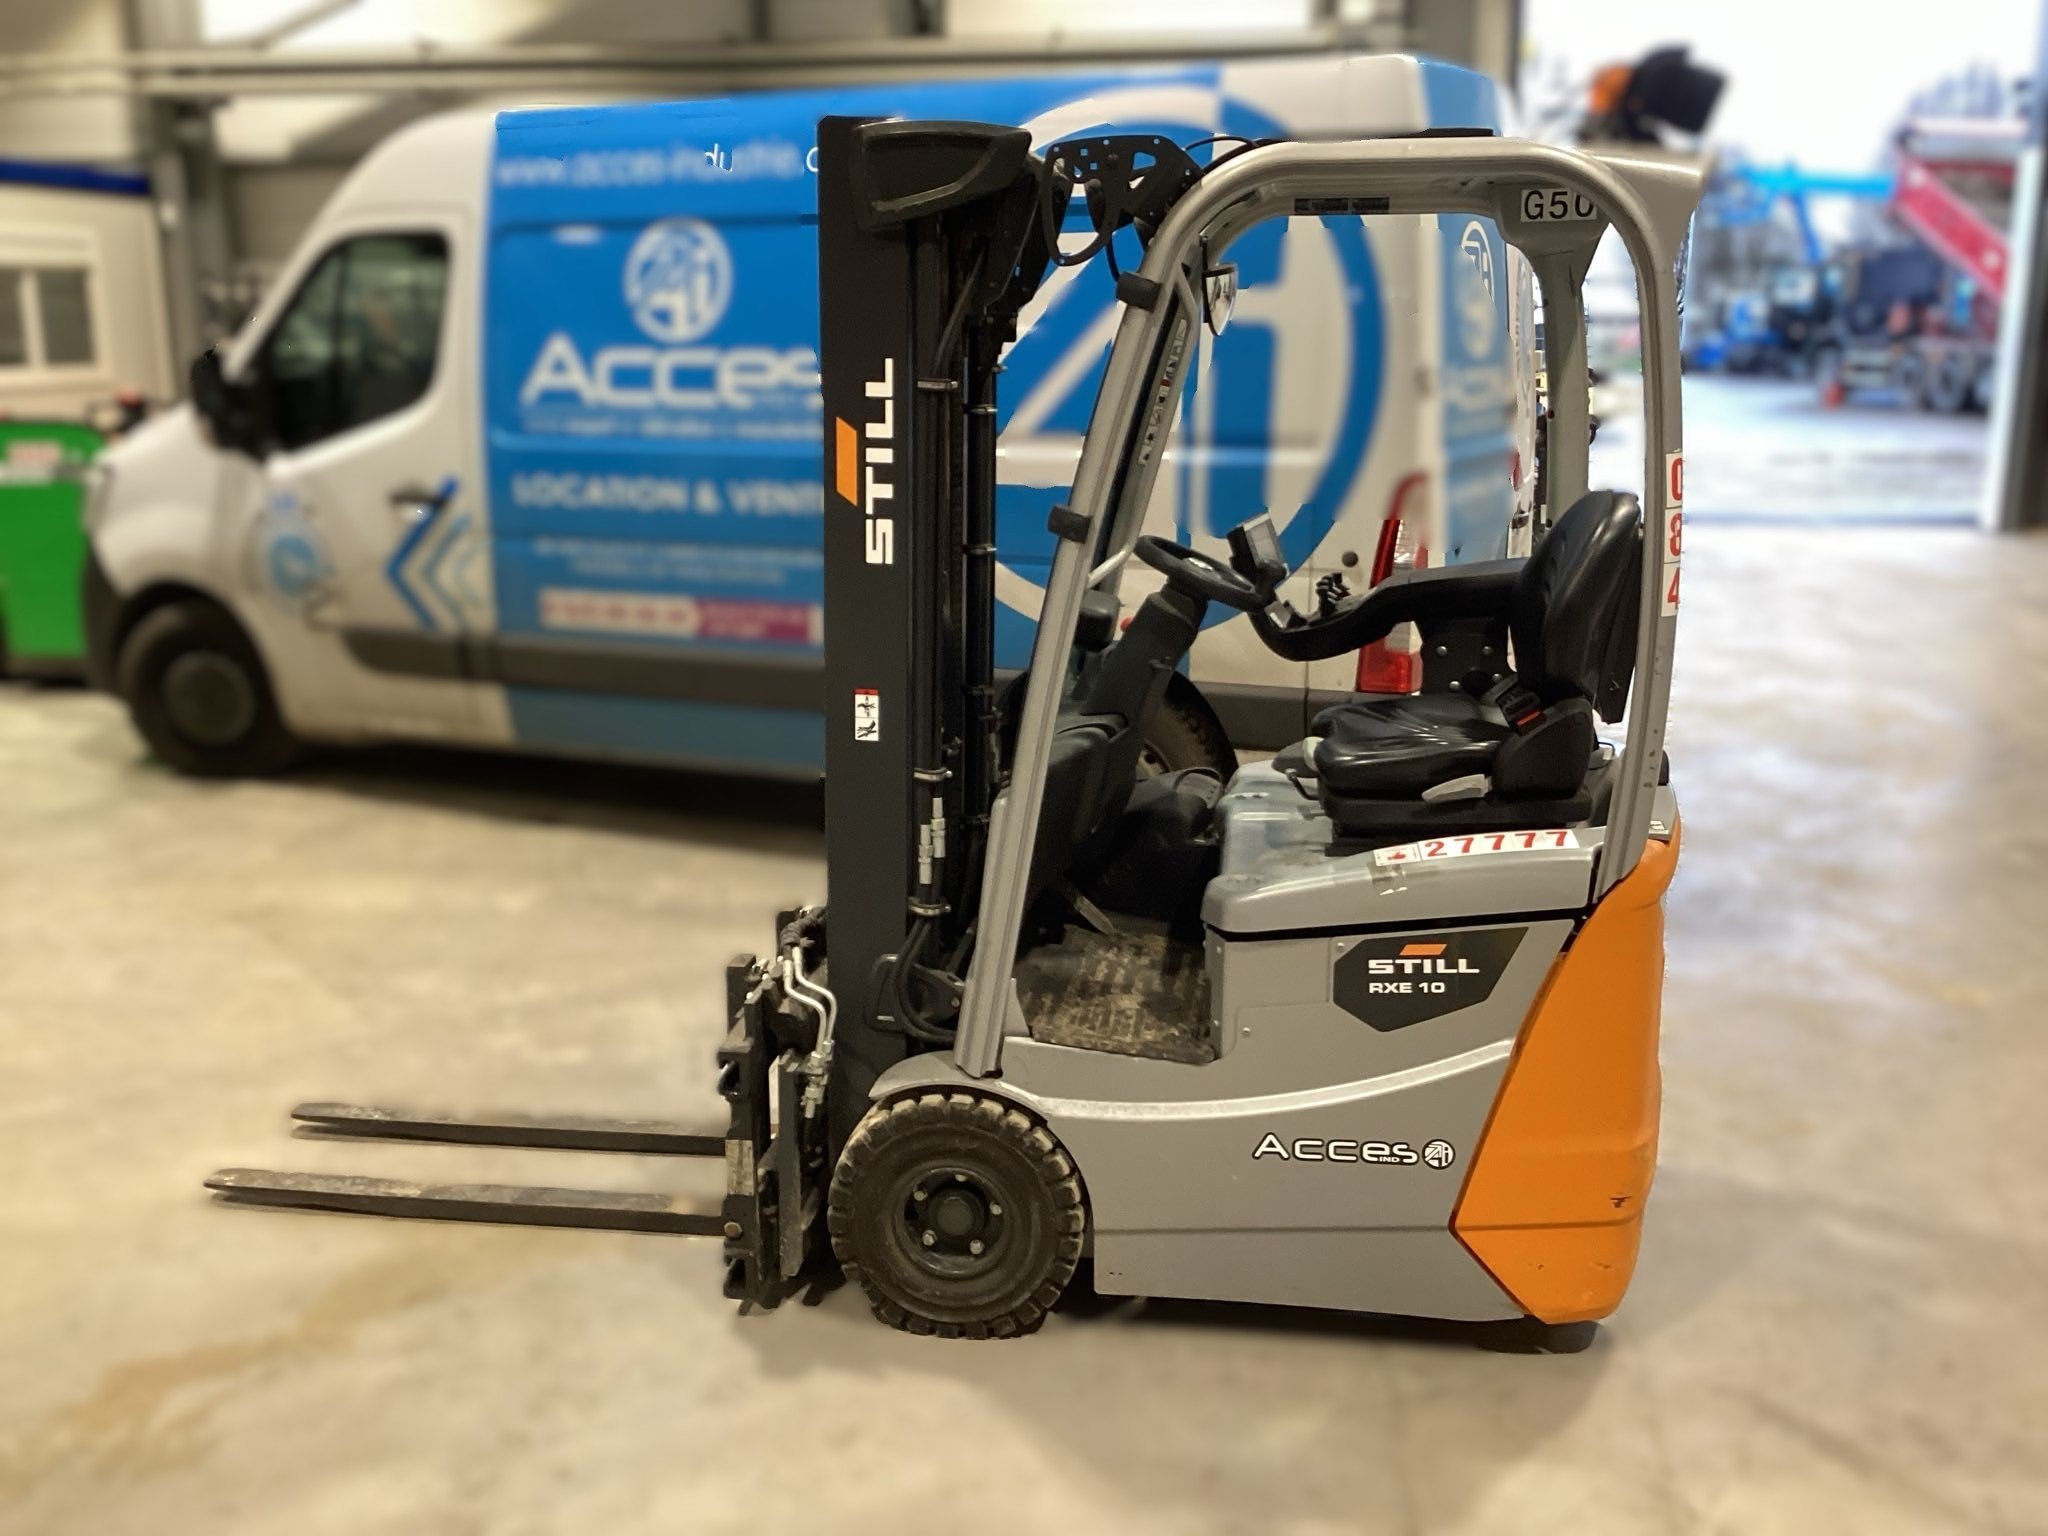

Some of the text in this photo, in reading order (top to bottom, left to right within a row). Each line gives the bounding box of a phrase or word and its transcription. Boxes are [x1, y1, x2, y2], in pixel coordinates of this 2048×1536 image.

[865, 358, 893, 564] STILL
[511, 471, 689, 511] LOCATION
[1425, 831, 1567, 857] 27777
[1368, 959, 1480, 974] STILL
[1369, 982, 1445, 993] RXE 10
[1252, 1132, 1420, 1166] Acces
[1379, 1155, 1400, 1163] IND
